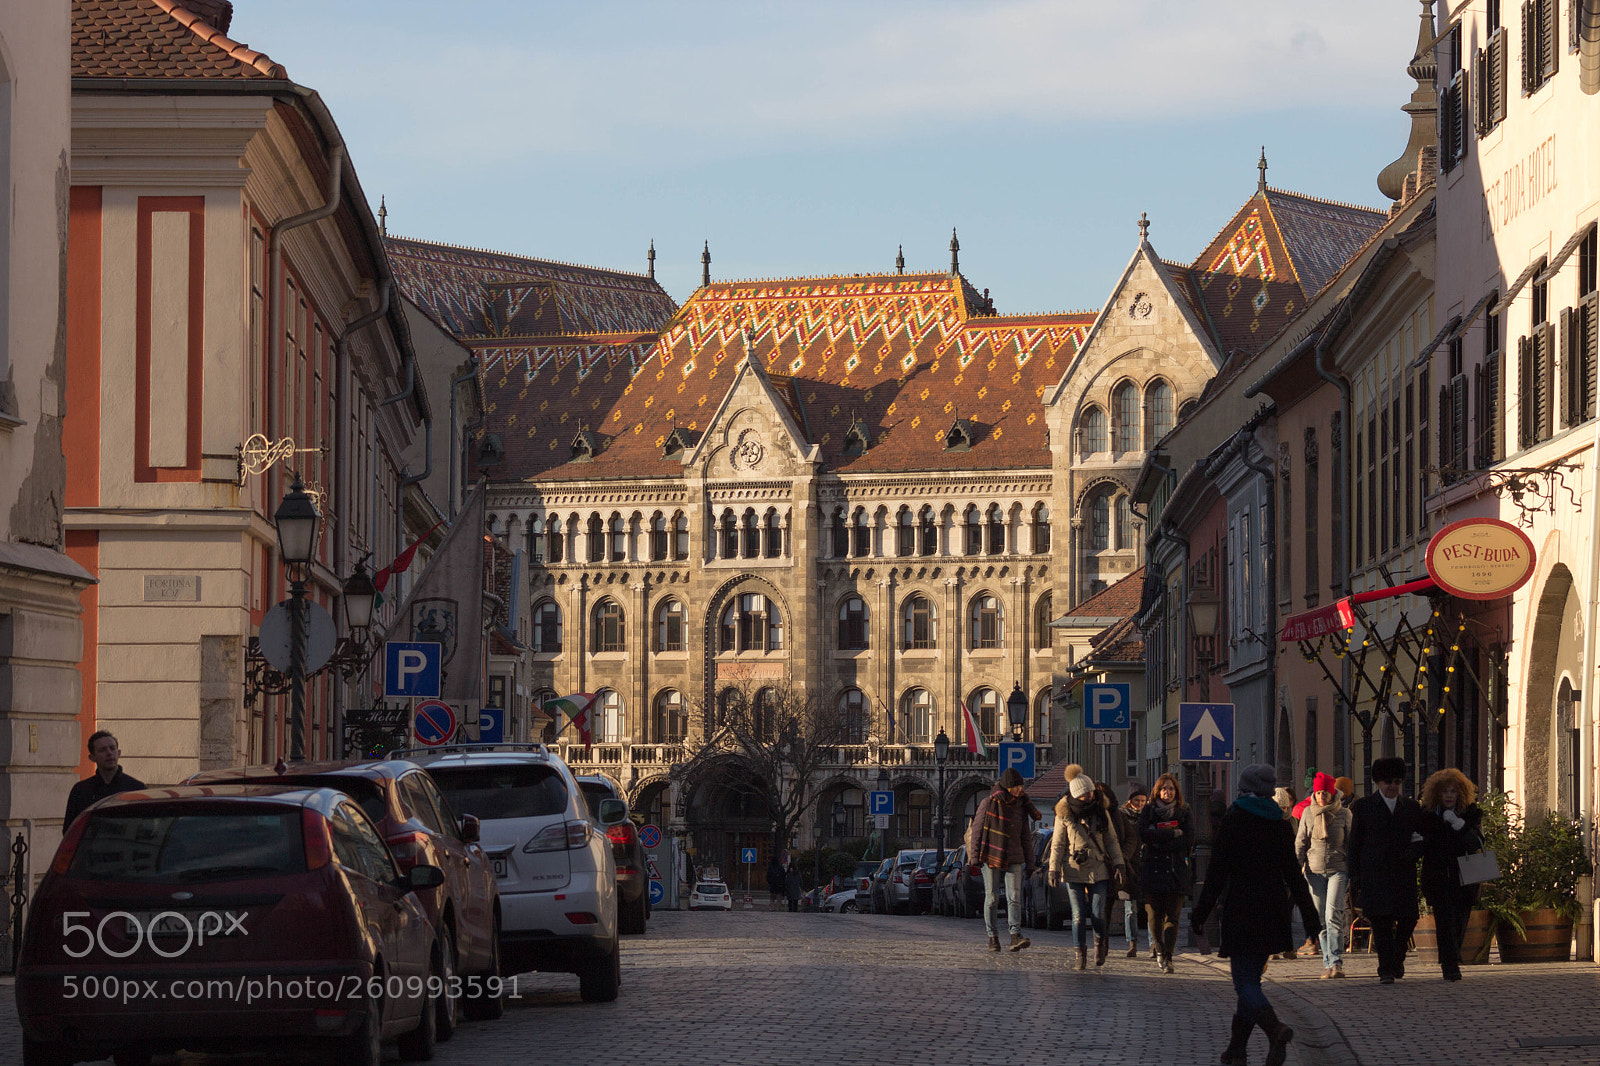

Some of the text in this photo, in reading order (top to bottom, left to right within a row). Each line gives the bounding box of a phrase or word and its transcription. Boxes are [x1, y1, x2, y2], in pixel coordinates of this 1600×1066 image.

[1482, 133, 1558, 244] PEST-BUDA HOTEL
[149, 578, 193, 590] FORTUNA
[398, 650, 428, 690] P
[365, 709, 402, 723] Hotel
[1093, 688, 1122, 724] P
[1007, 747, 1027, 769] P
[875, 793, 889, 812] P
